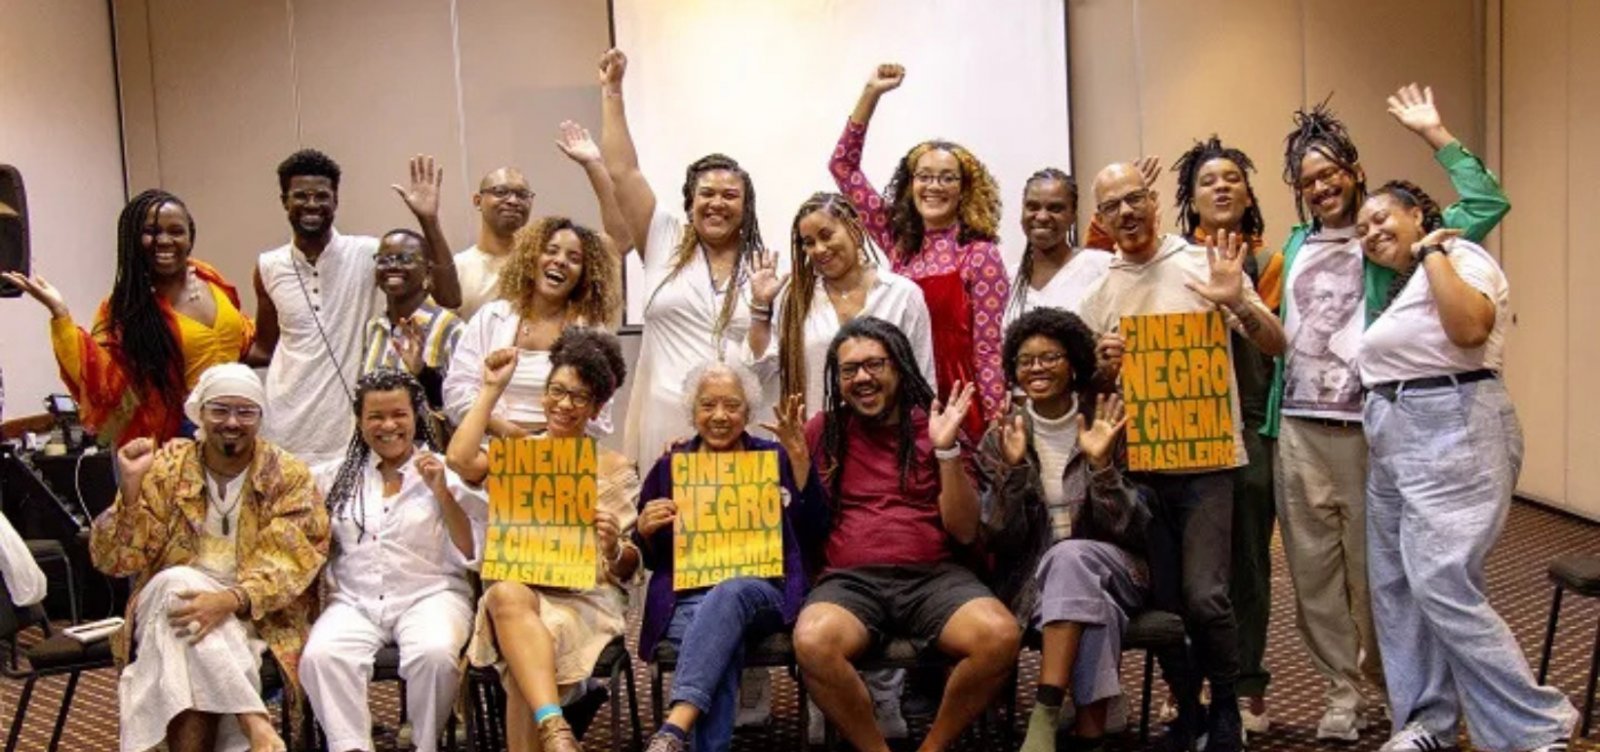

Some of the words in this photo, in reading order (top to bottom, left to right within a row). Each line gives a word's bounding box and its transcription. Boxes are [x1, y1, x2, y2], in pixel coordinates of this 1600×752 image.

[1121, 312, 1226, 351] CINEMA
[1122, 348, 1229, 400] NEGRO
[1125, 404, 1140, 442] E
[1144, 397, 1232, 441] CINEMA
[489, 438, 597, 474] CINEMA
[672, 451, 779, 485] CINEMA
[1128, 440, 1234, 470] BRASILEIRO
[488, 475, 597, 525] NEGRO
[673, 483, 781, 532] NEGRO
[484, 526, 500, 560] E
[504, 526, 596, 564] CINEMA
[675, 534, 688, 569] E
[692, 530, 782, 568] CINEMA
